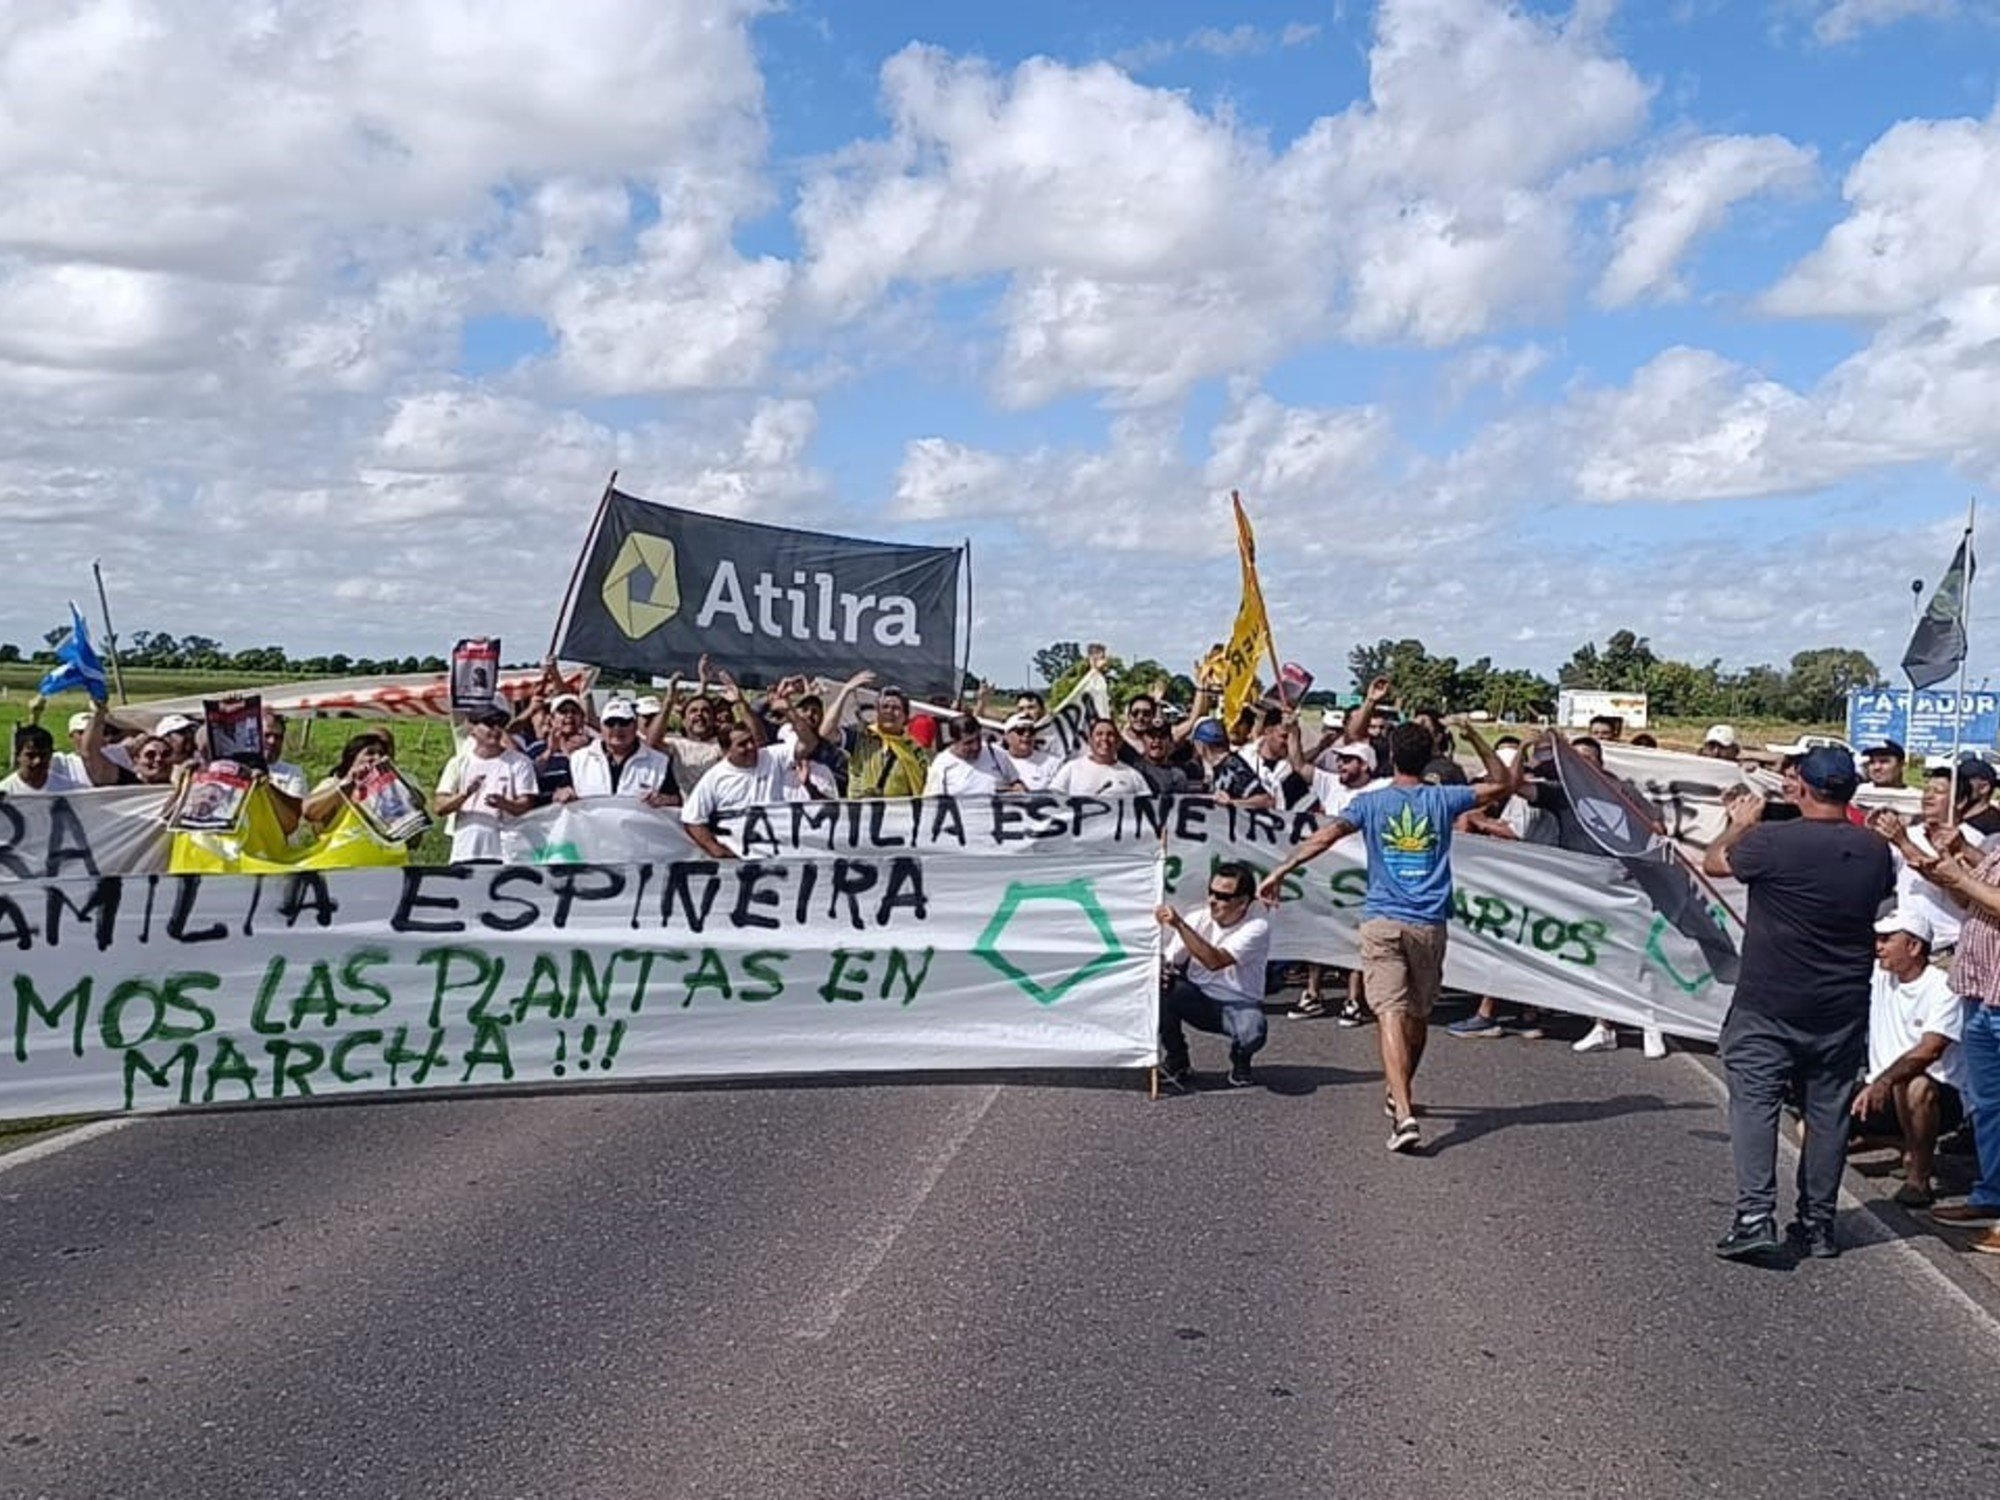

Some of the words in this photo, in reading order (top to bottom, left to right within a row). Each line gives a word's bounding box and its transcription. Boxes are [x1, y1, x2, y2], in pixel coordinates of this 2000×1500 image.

[697, 560, 920, 646] Atilra
[709, 795, 966, 855] FAMILIA
[990, 793, 1322, 844] ESPINEIRA
[391, 857, 928, 932] ESPINEIRA
[250, 947, 391, 1034] LAS
[416, 946, 790, 1028] PLANTAS
[817, 946, 935, 1005] EN
[122, 1019, 514, 1110] MARCHA
[551, 1018, 626, 1076] !!!
